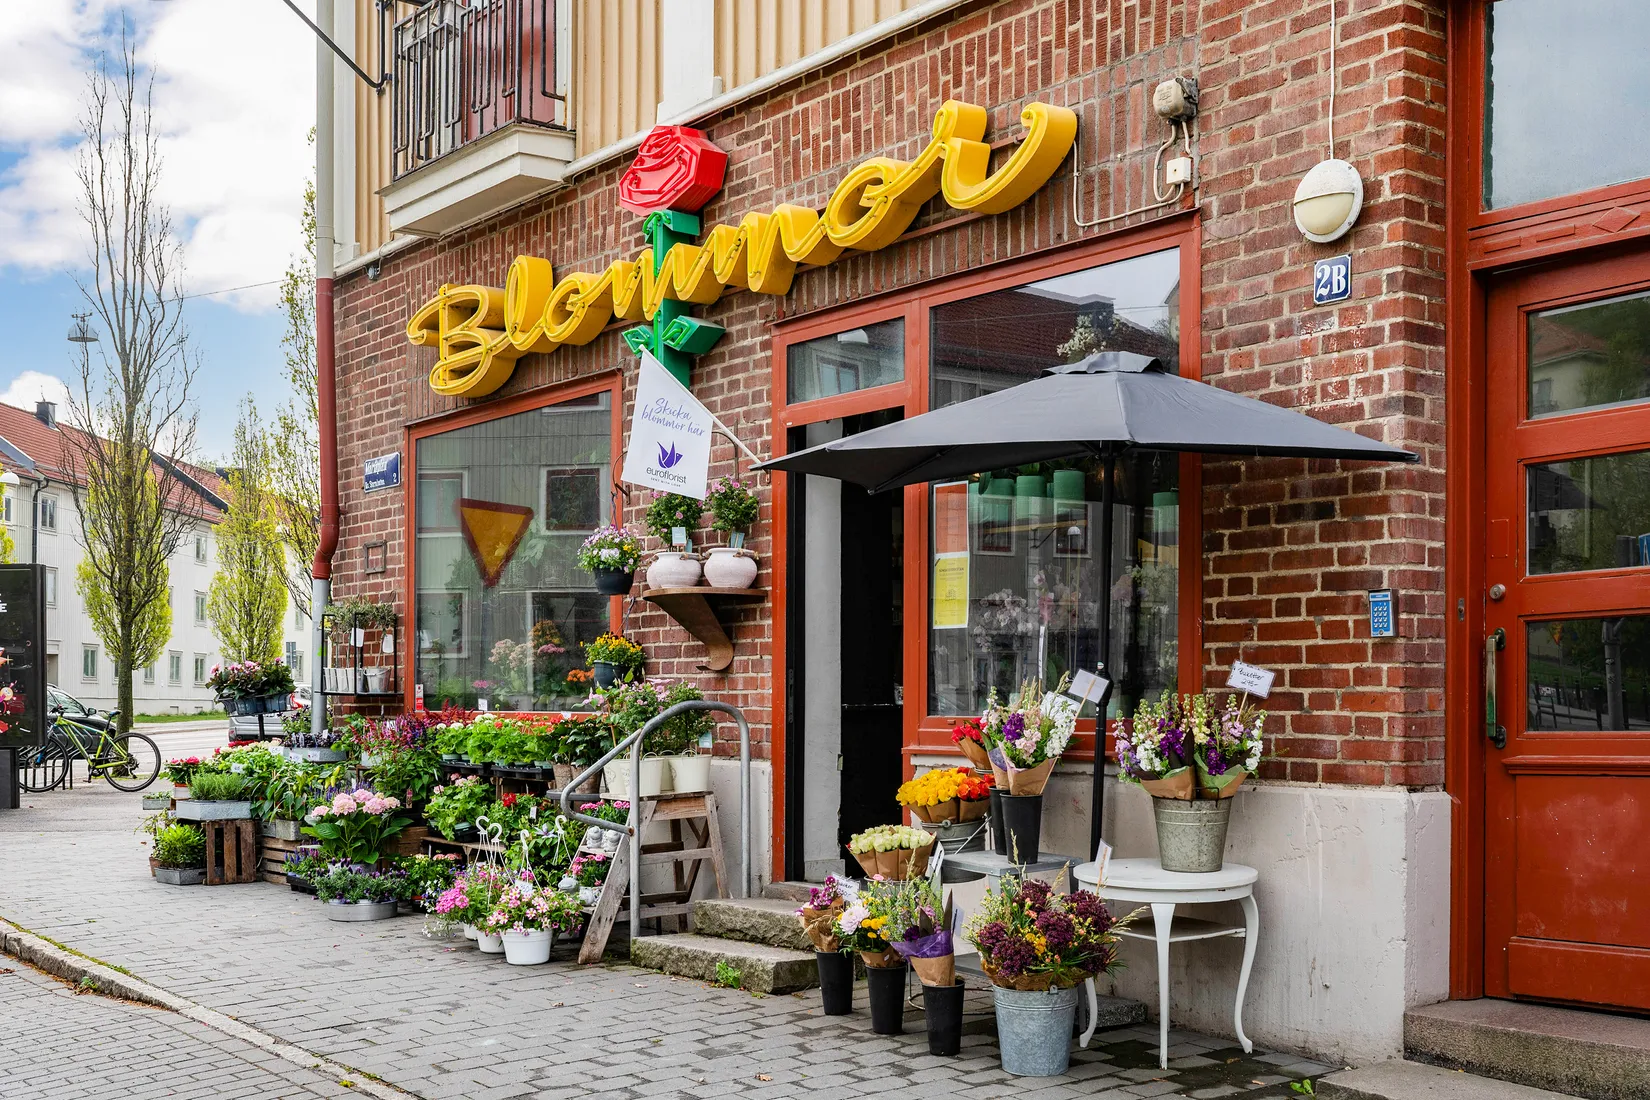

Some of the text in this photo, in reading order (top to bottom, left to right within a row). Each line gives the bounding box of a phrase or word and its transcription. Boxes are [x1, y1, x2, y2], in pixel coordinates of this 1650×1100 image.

[406, 99, 1078, 397] Blommor
[1316, 264, 1346, 298] 2B
[641, 404, 705, 437] blommor här
[654, 397, 692, 421] Skicka
[646, 466, 687, 484] euroflorist
